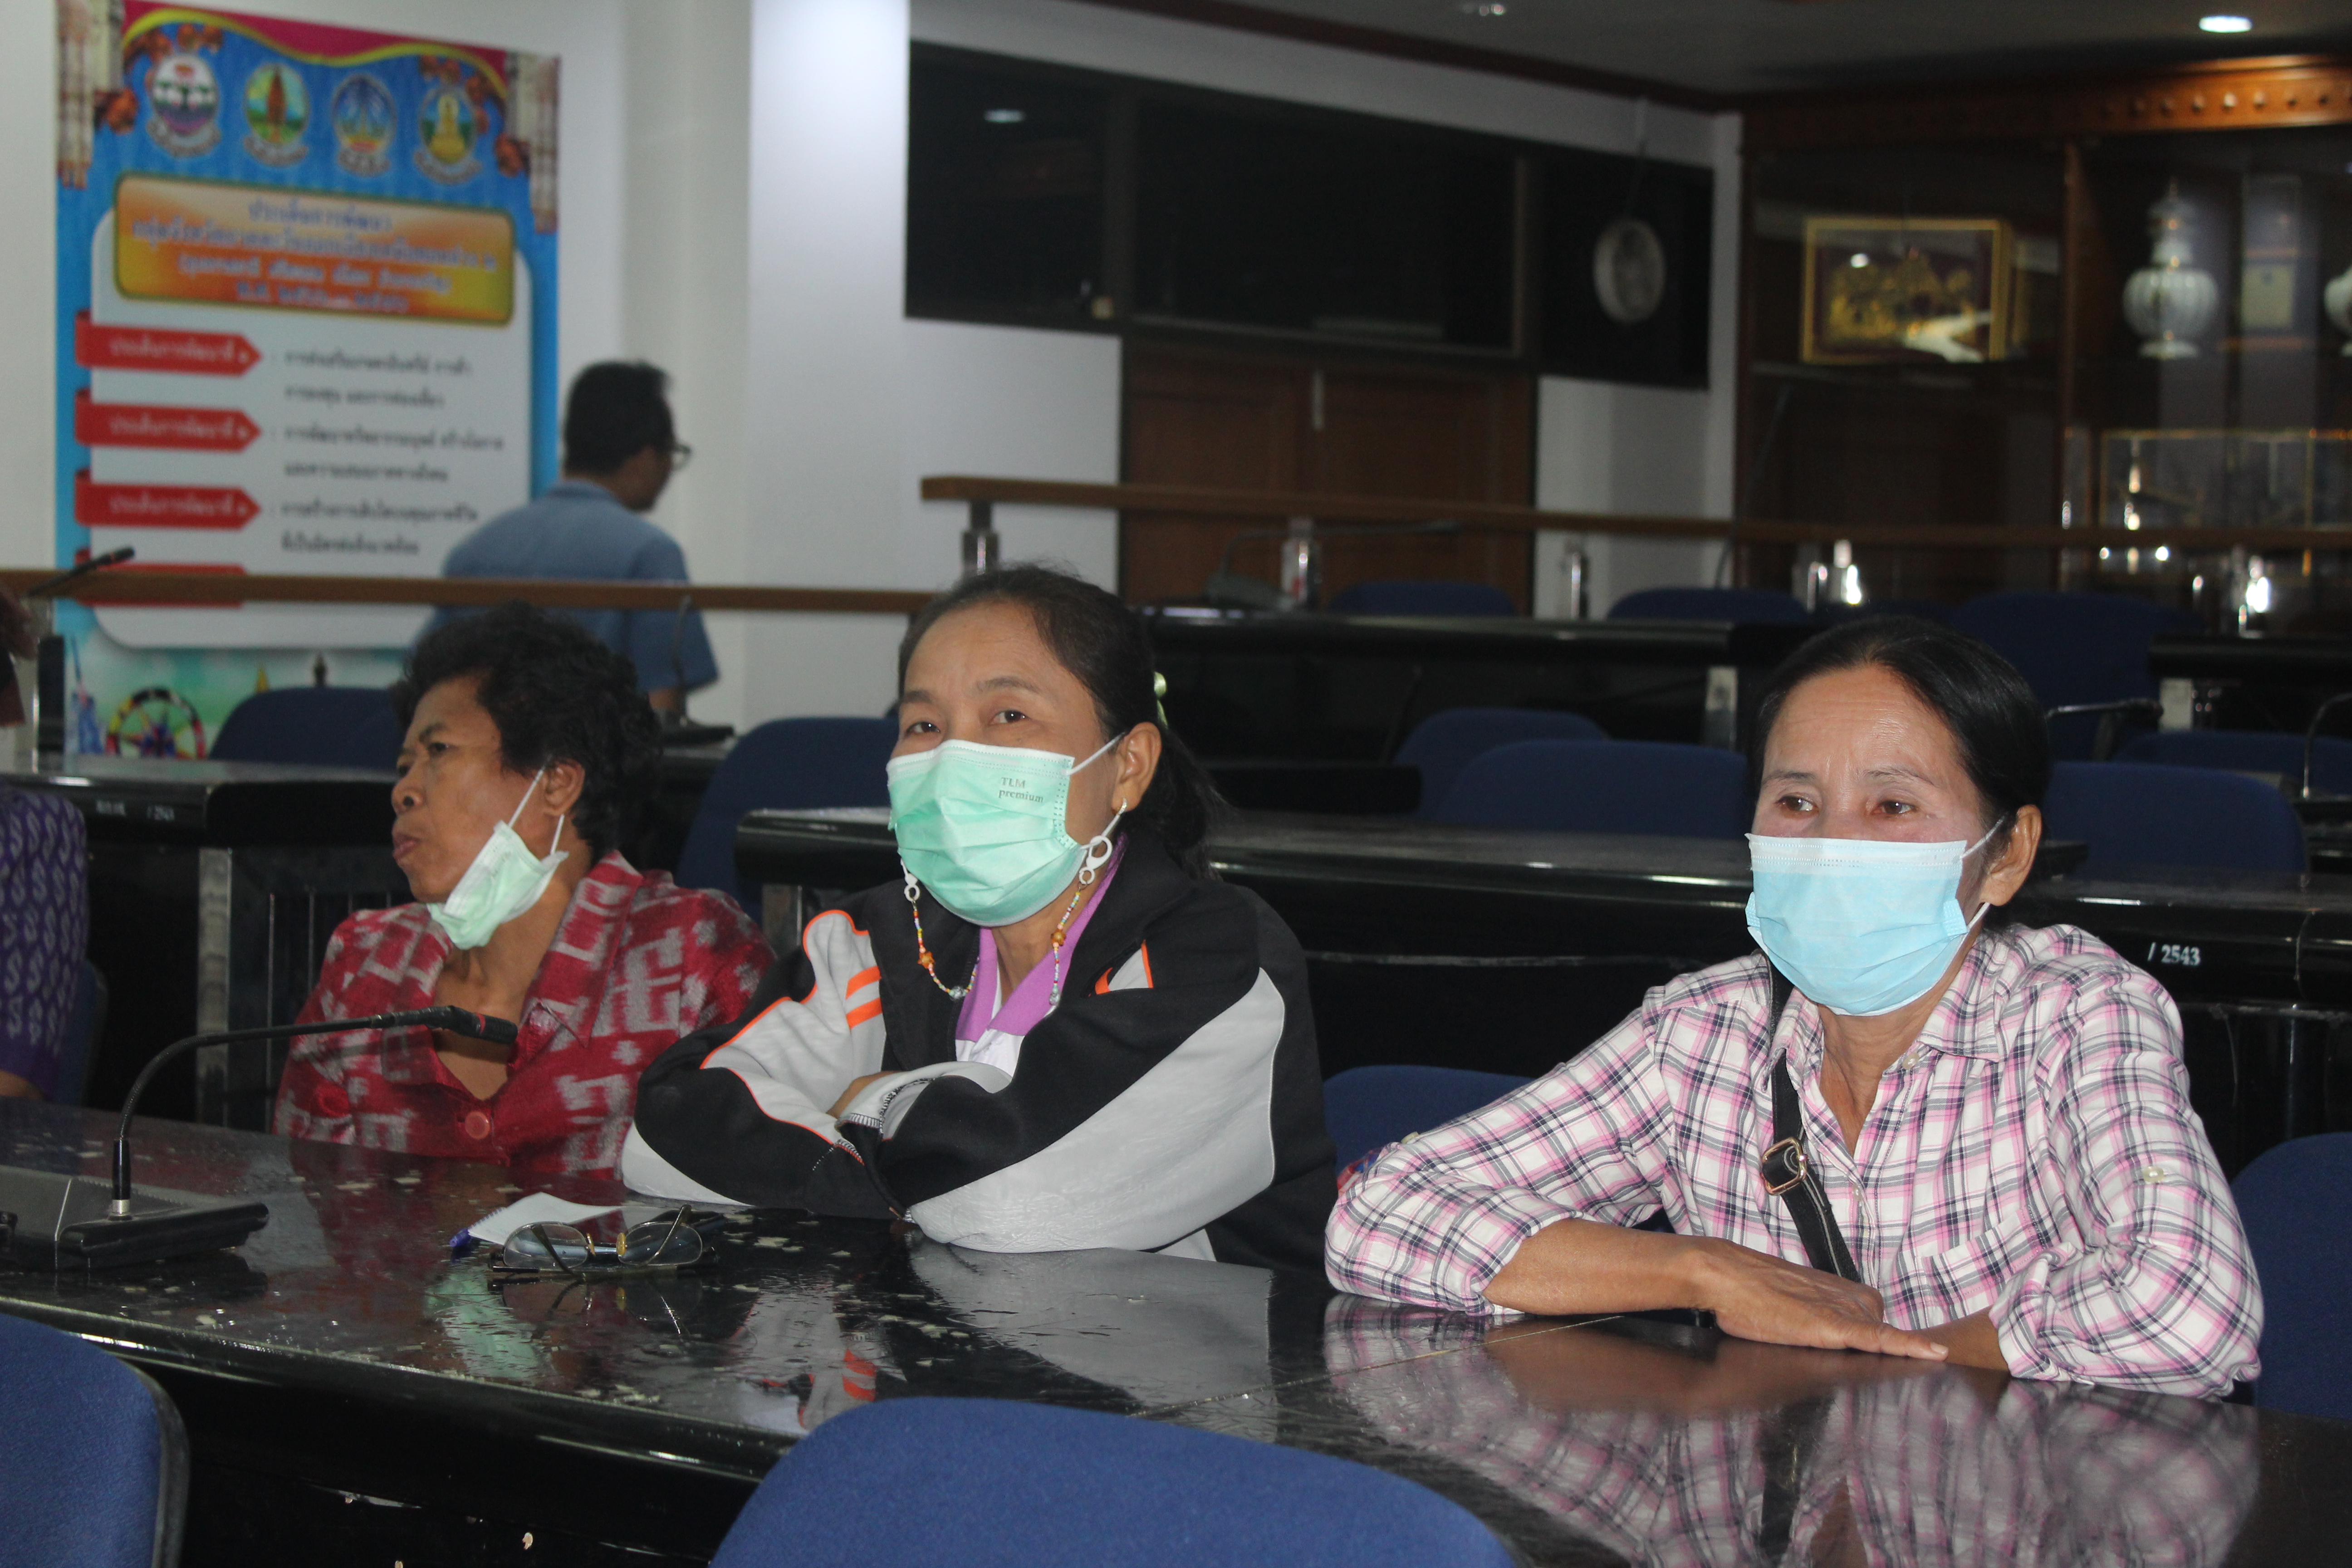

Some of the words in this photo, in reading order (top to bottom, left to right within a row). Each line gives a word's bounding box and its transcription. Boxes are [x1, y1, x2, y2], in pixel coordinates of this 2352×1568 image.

[1001, 777, 1026, 788] TLM
[999, 790, 1044, 803] premium
[2161, 944, 2201, 966] 2543
